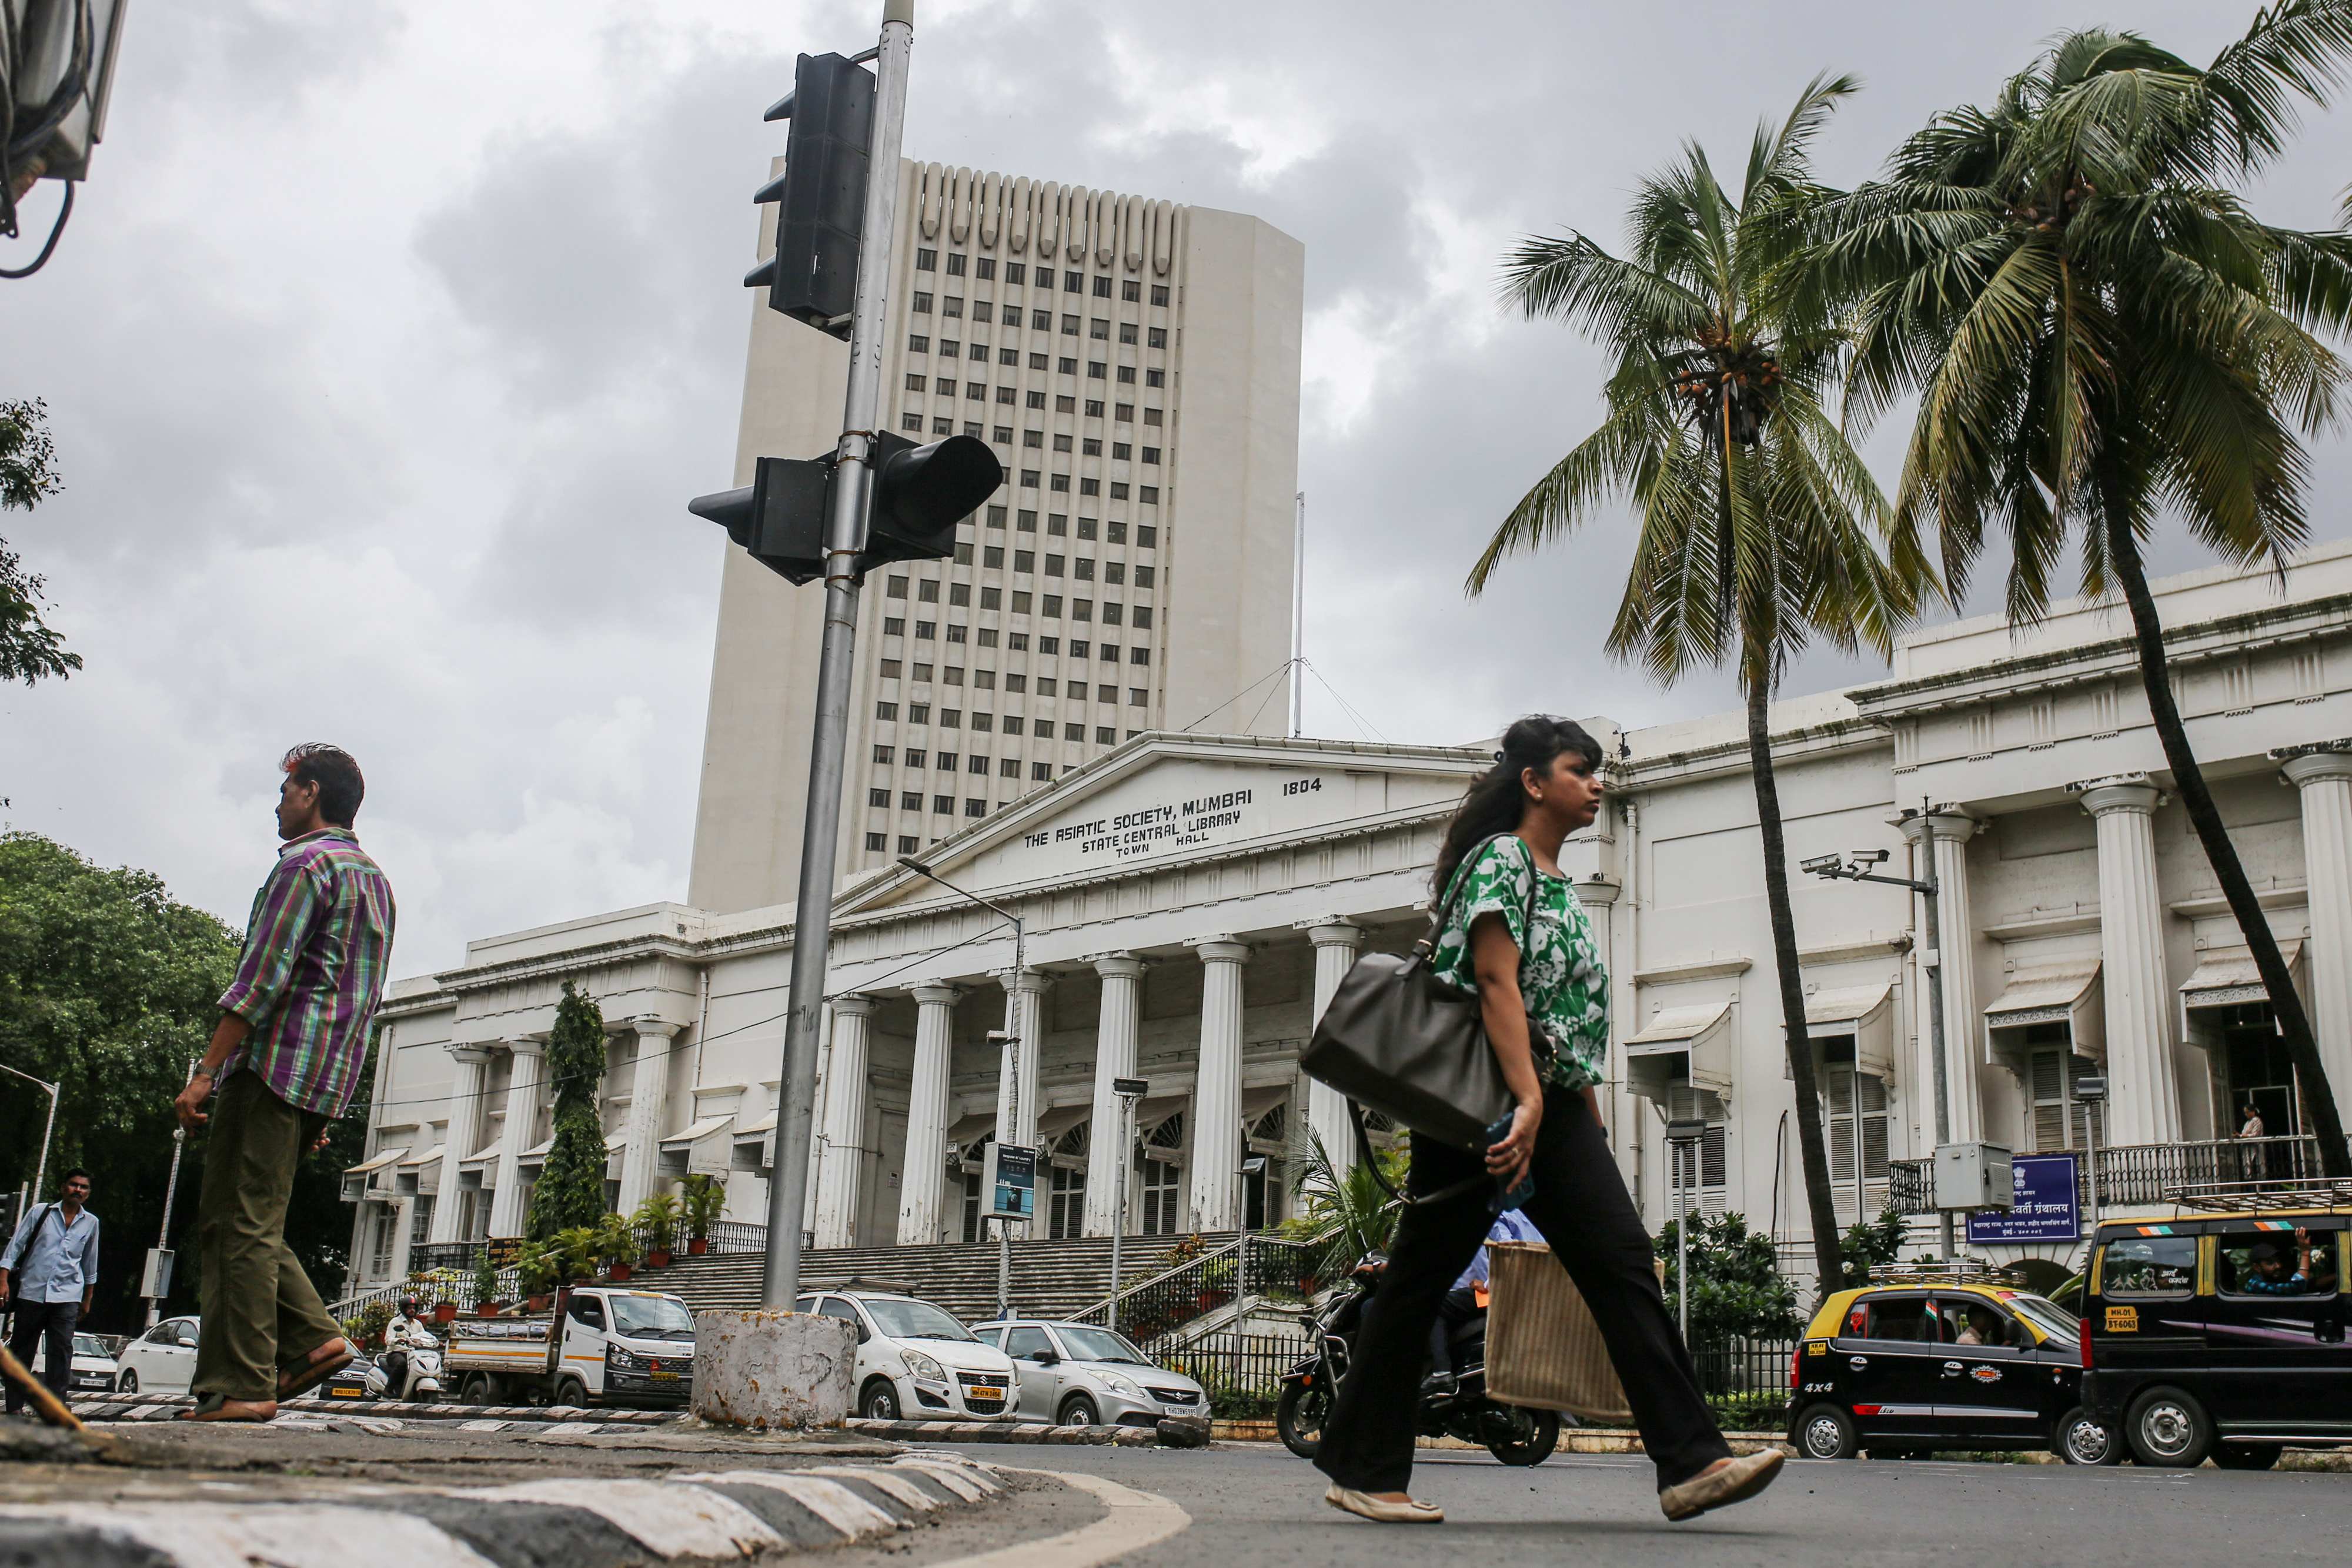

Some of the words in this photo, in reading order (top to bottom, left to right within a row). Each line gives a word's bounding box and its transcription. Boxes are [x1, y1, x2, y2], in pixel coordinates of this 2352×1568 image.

[1284, 777, 1322, 797] 1804
[1024, 833, 1048, 848] THE
[1055, 820, 1105, 843] ASIATIC
[1113, 805, 1177, 831] SOCIETY,
[1182, 788, 1252, 817] MUMBAI
[1082, 838, 1119, 853] STATE
[1124, 823, 1180, 844] CENTRAL
[1188, 810, 1241, 831] LIBRARY
[1116, 844, 1149, 858] TOWN
[1176, 832, 1209, 847] HALL
[2034, 1202, 2069, 1215] ग्रंथालय
